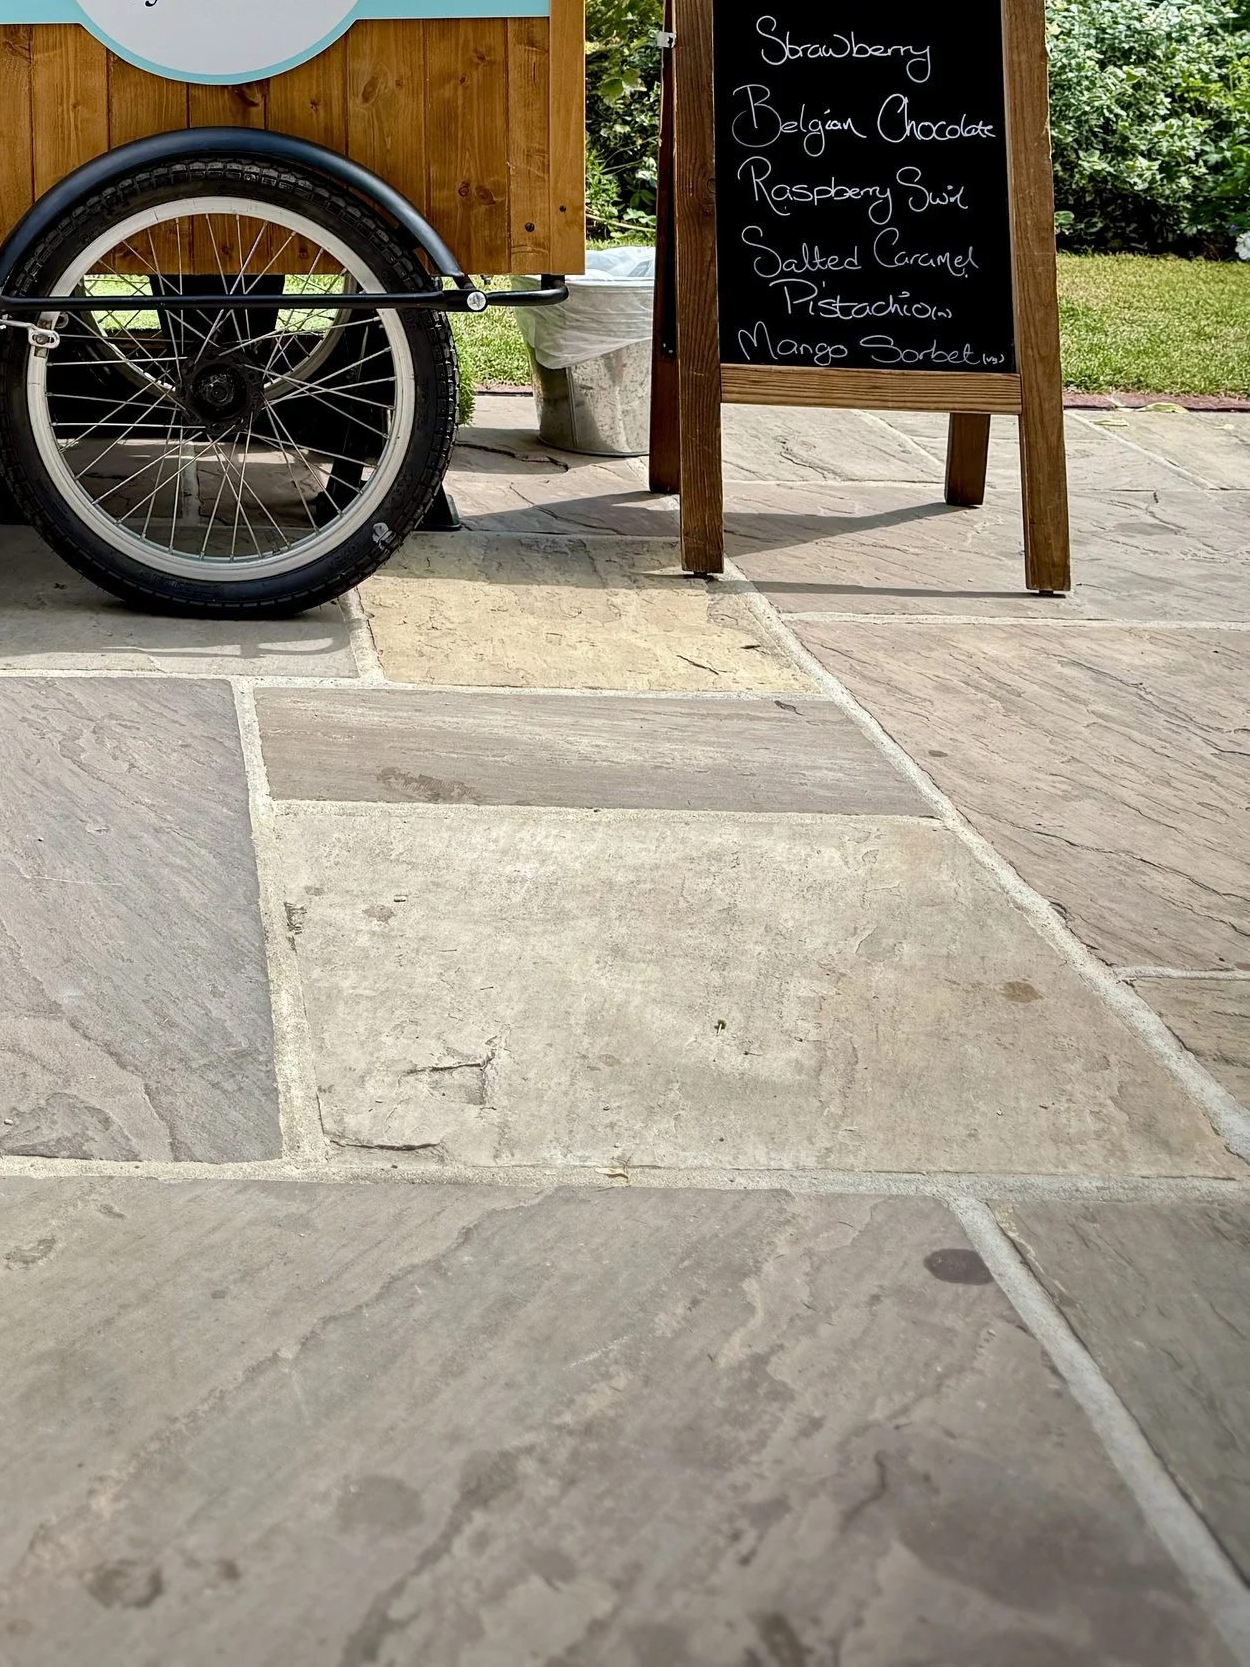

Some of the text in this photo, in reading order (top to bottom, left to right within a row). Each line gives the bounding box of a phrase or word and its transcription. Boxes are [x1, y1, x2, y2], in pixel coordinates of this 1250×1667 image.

[756, 15, 931, 83] Strawberry
[731, 84, 997, 157] Belgian Chocolate
[737, 156, 893, 225] Raspberry
[741, 225, 980, 278] Salted Caramel
[737, 320, 849, 366] Mango
